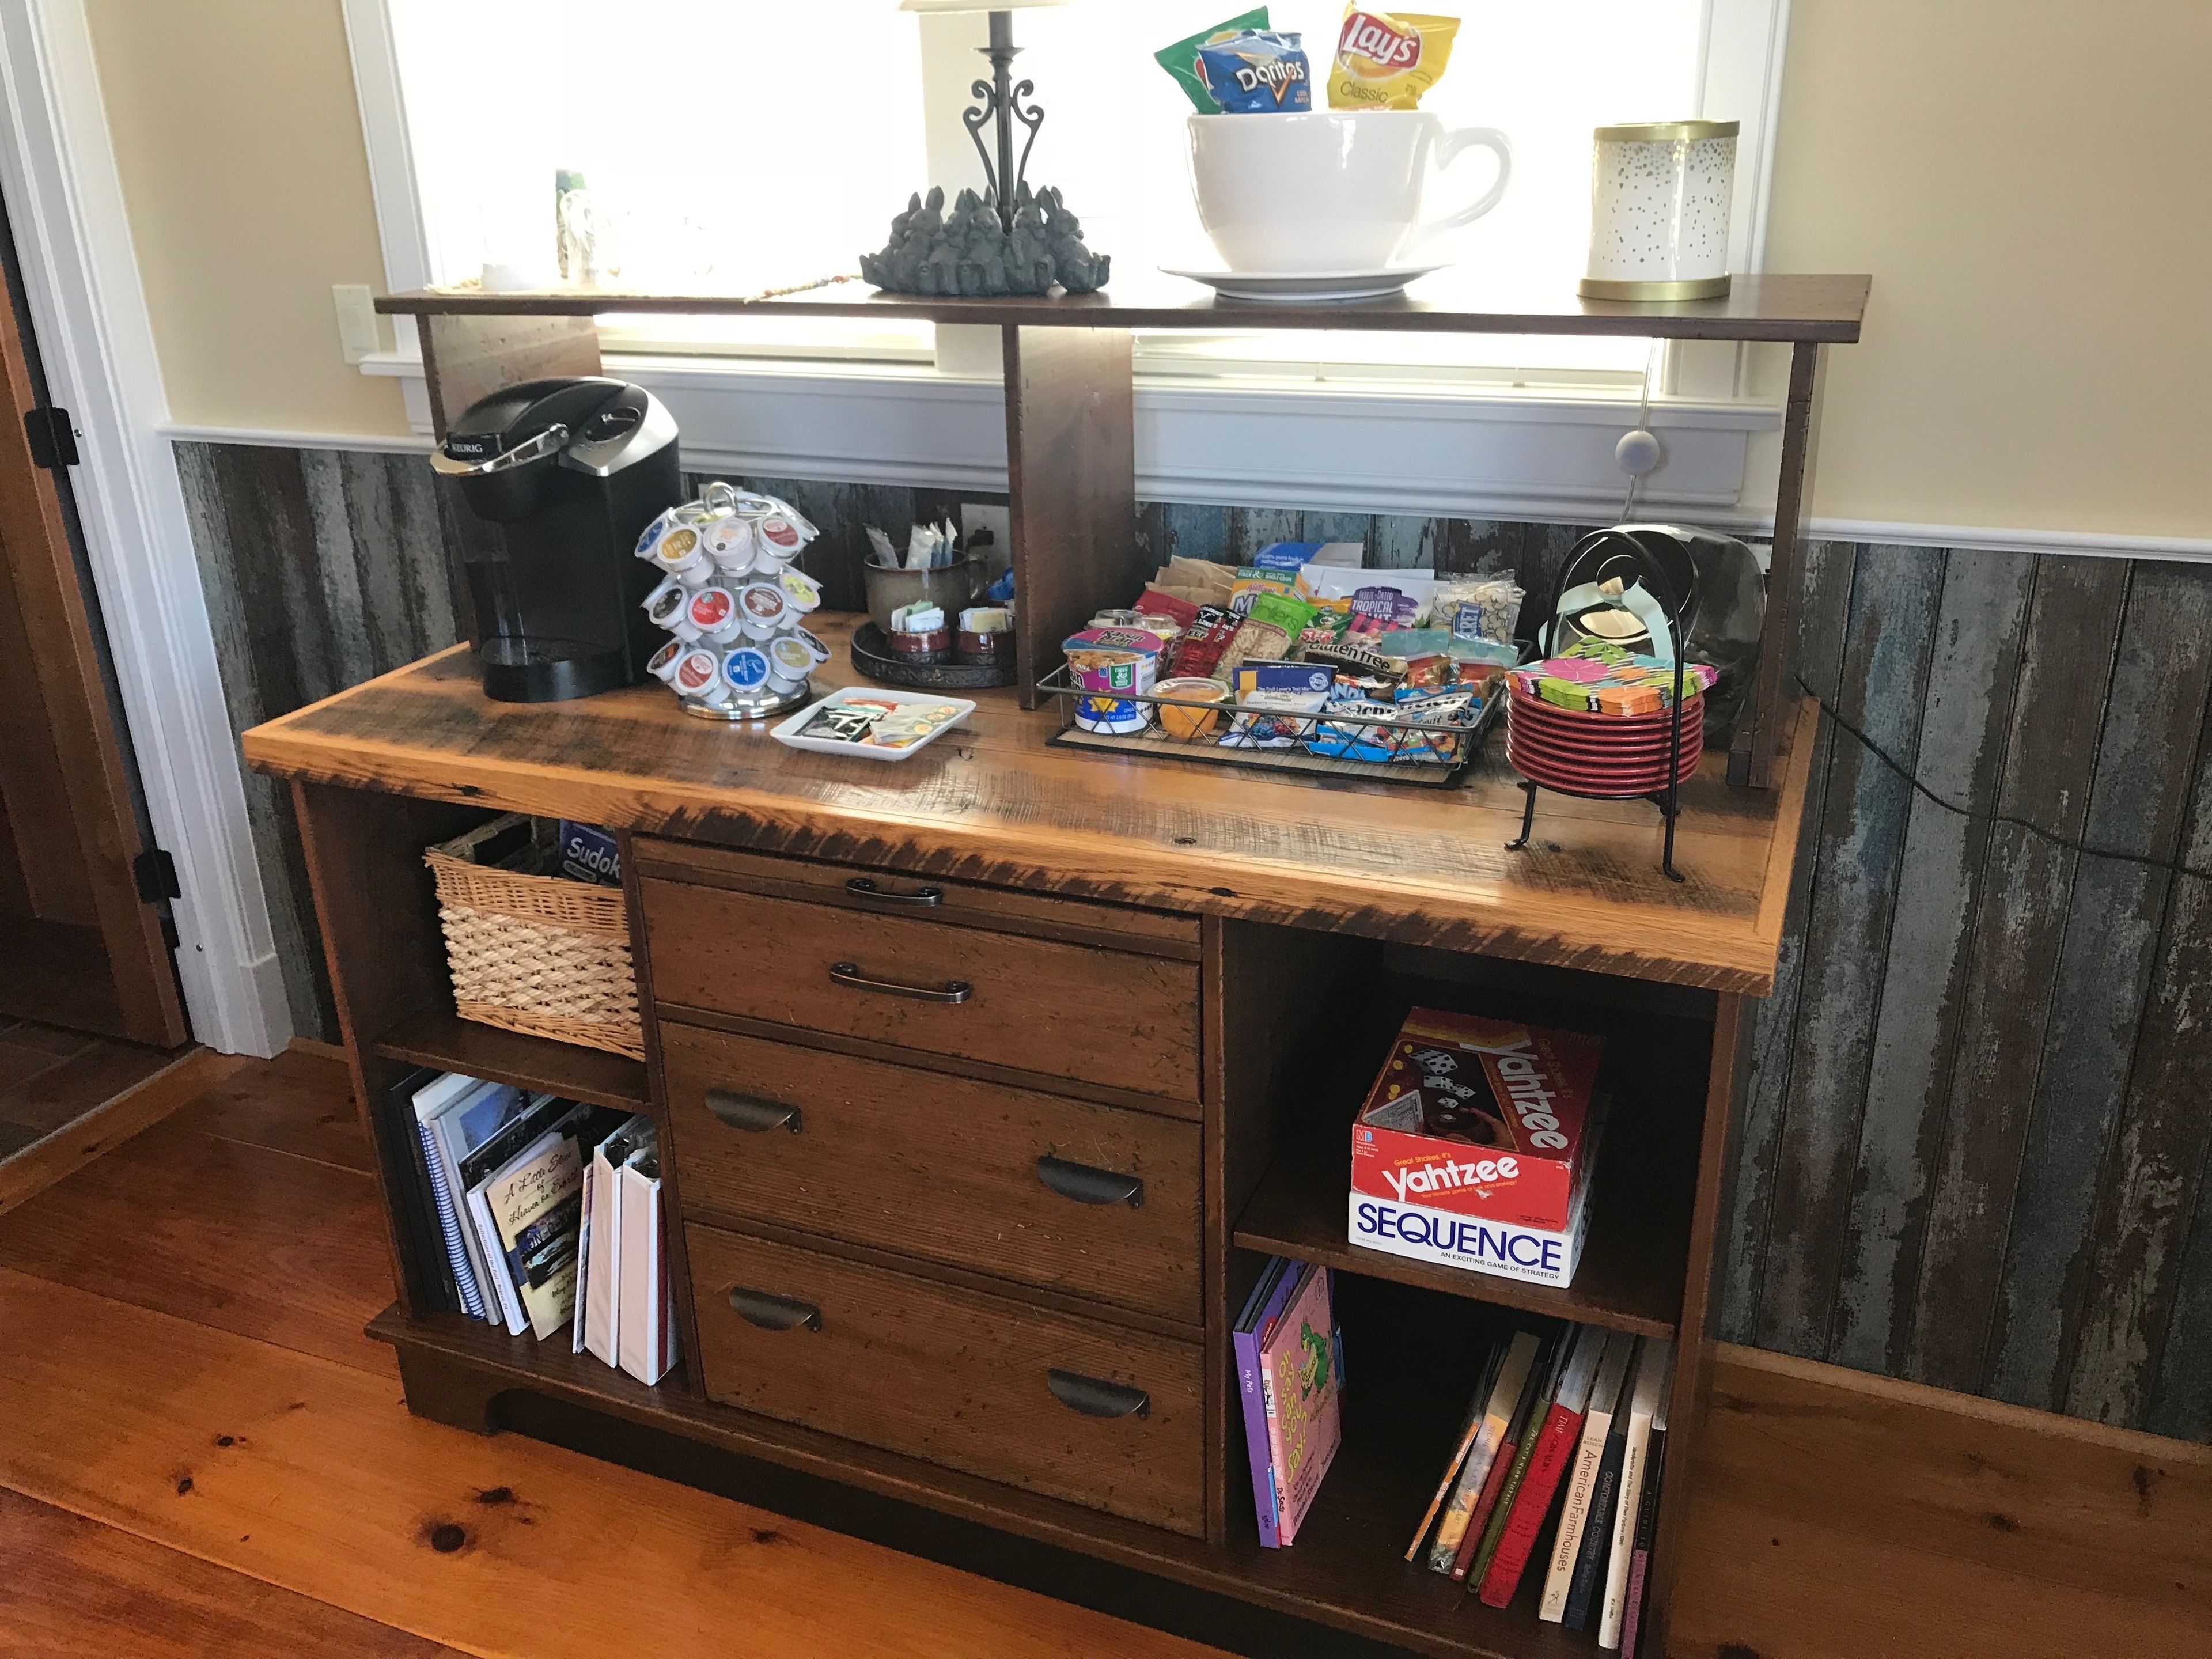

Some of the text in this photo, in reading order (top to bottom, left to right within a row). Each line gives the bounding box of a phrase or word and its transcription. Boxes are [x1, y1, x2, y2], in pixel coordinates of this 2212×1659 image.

[1343, 14, 1416, 65] Lay's
[1236, 61, 1305, 92] Doritos
[1340, 81, 1388, 103] Classic
[451, 444, 483, 453] KEURIG
[1352, 600, 1393, 613] TROPICAL
[1076, 664, 1092, 672] PULL
[1360, 651, 1390, 669] free
[567, 836, 620, 878] Sudok
[1460, 1039, 1569, 1150] Yahtzee
[1394, 1157, 1413, 1166] Great
[1381, 1157, 1520, 1202] Yahtzee
[505, 1183, 515, 1205] A
[1357, 1203, 1562, 1272] SEQUENCE
[1452, 1255, 1485, 1266] EXCITING
[1487, 1262, 1508, 1270] GAME
[1521, 1268, 1559, 1279] STRATEGY
[1244, 1369, 1251, 1381] My
[1277, 1495, 1285, 1513] Seuss
